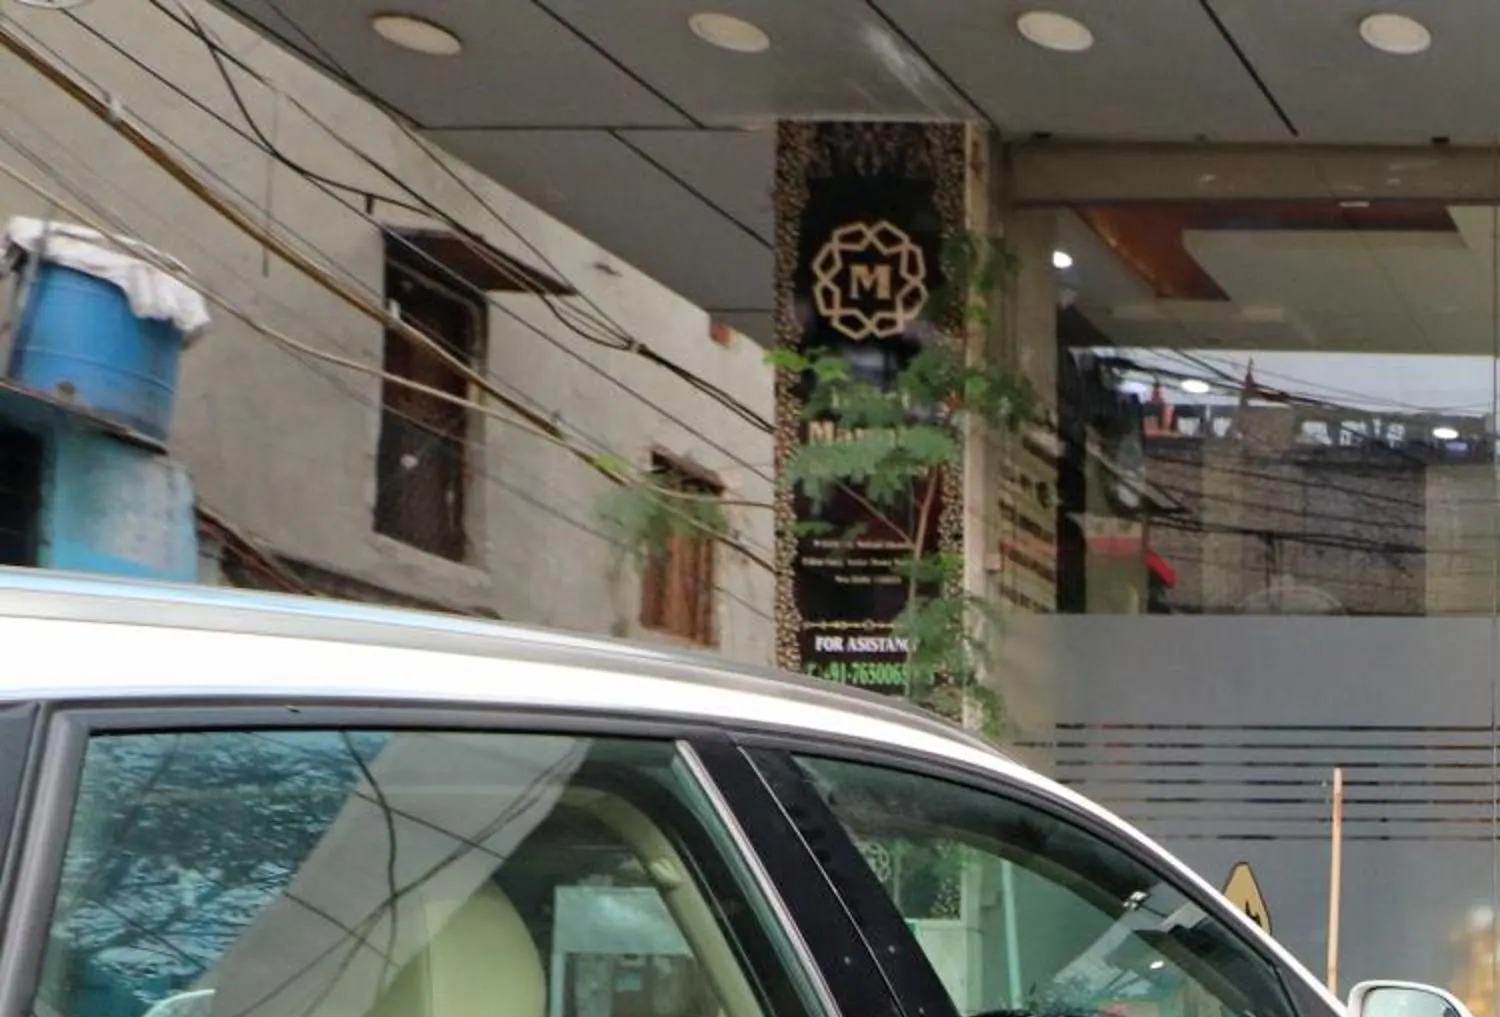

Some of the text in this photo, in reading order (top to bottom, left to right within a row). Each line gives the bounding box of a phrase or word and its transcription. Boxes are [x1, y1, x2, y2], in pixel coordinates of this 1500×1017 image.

[849, 265, 891, 299] M
[815, 636, 917, 652] FOR ASISTANC
